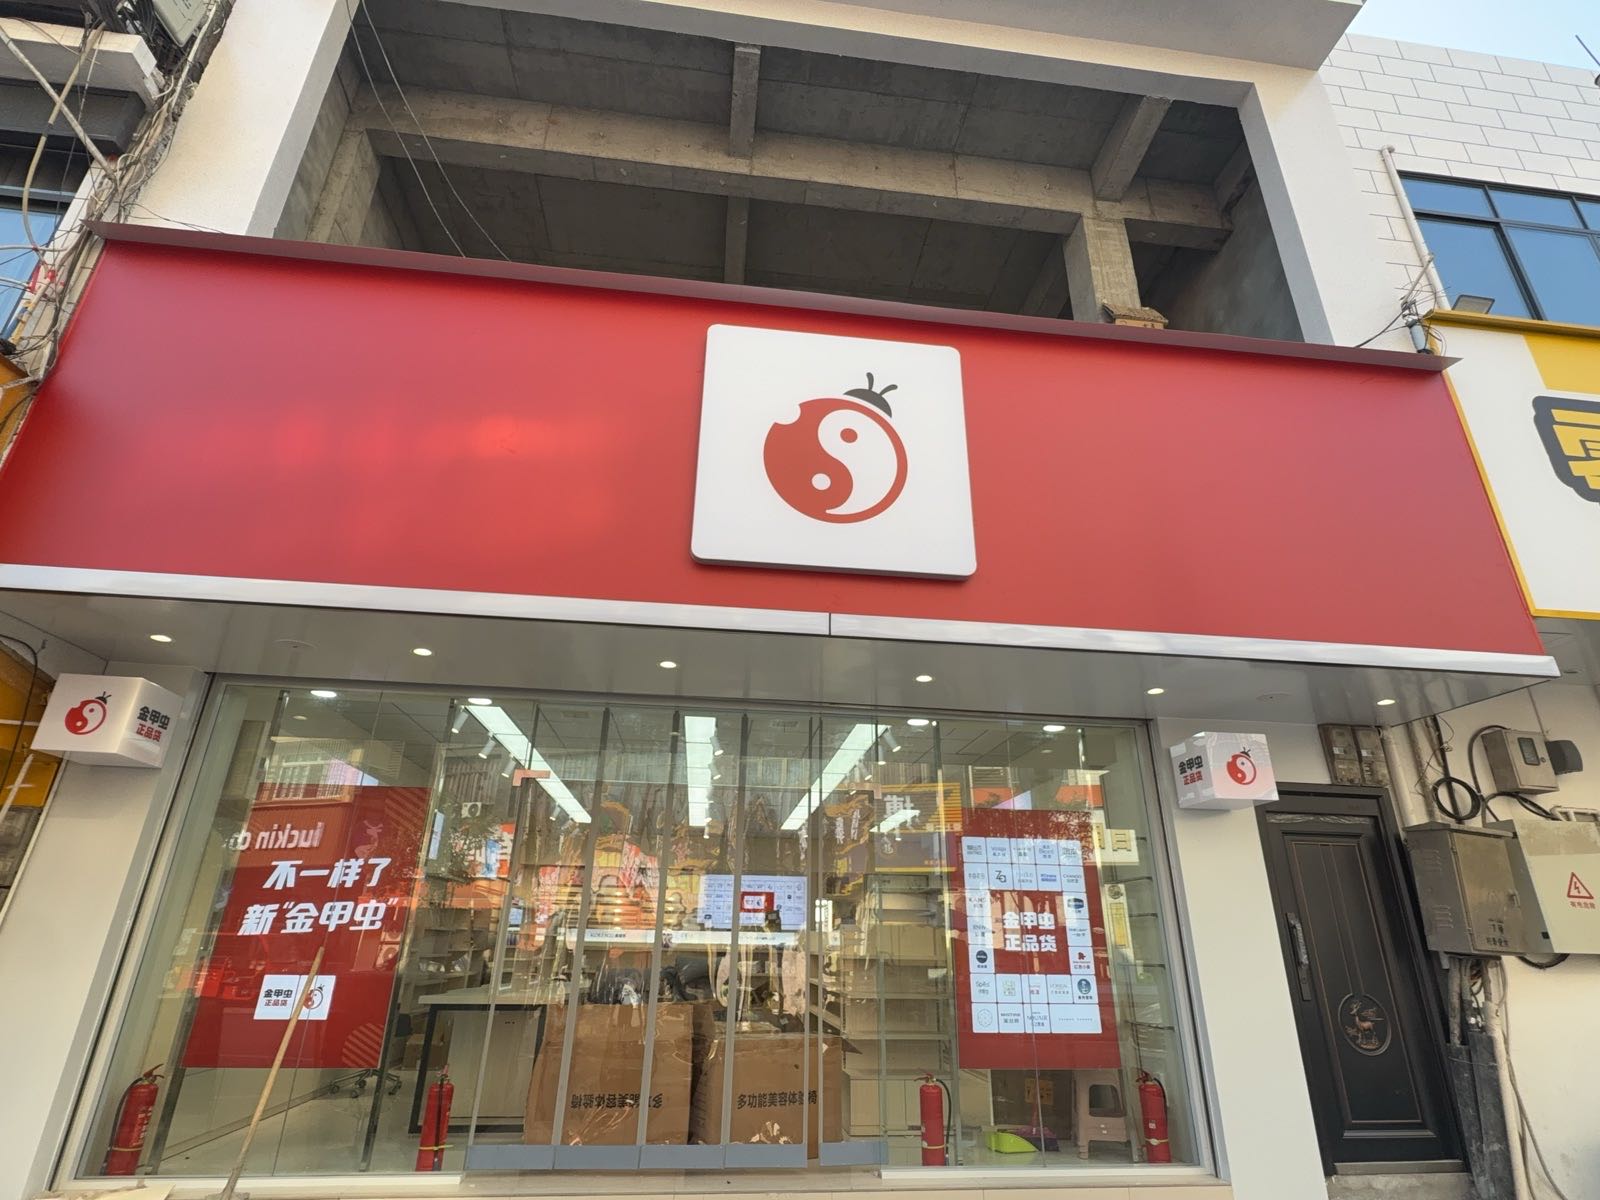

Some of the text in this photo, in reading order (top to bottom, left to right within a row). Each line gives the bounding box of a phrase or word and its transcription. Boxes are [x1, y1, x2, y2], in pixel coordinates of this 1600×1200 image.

[137, 706, 170, 730] 金甲虫
[1179, 755, 1203, 775] 金甲虫
[262, 858, 392, 890] 不一样了
[1003, 911, 1055, 929] 金甲虫
[1004, 934, 1057, 952] 正品货
[264, 989, 293, 998] 金甲虫
